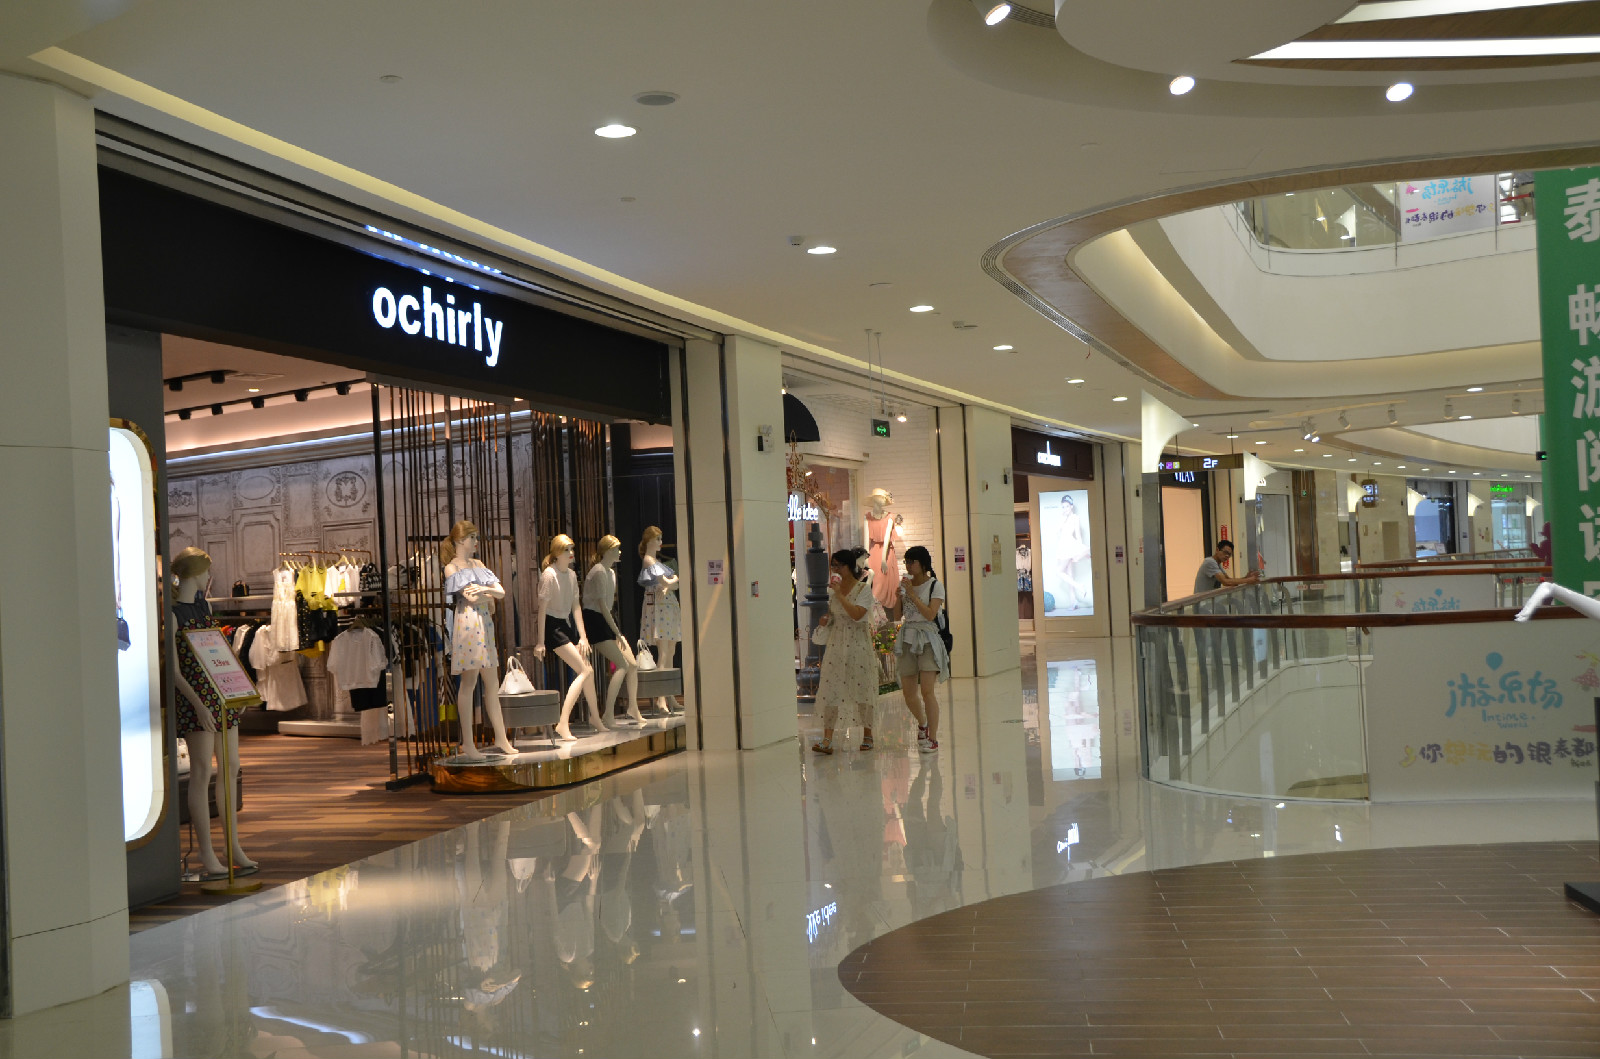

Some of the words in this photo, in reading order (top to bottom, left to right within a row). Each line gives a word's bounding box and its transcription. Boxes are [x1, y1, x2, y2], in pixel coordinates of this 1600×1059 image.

[372, 286, 504, 368] ochirly
[1202, 457, 1219, 469] 2F
[1444, 670, 1564, 718] 游乐场
[1419, 737, 1597, 766] 你想玩的银泰都
